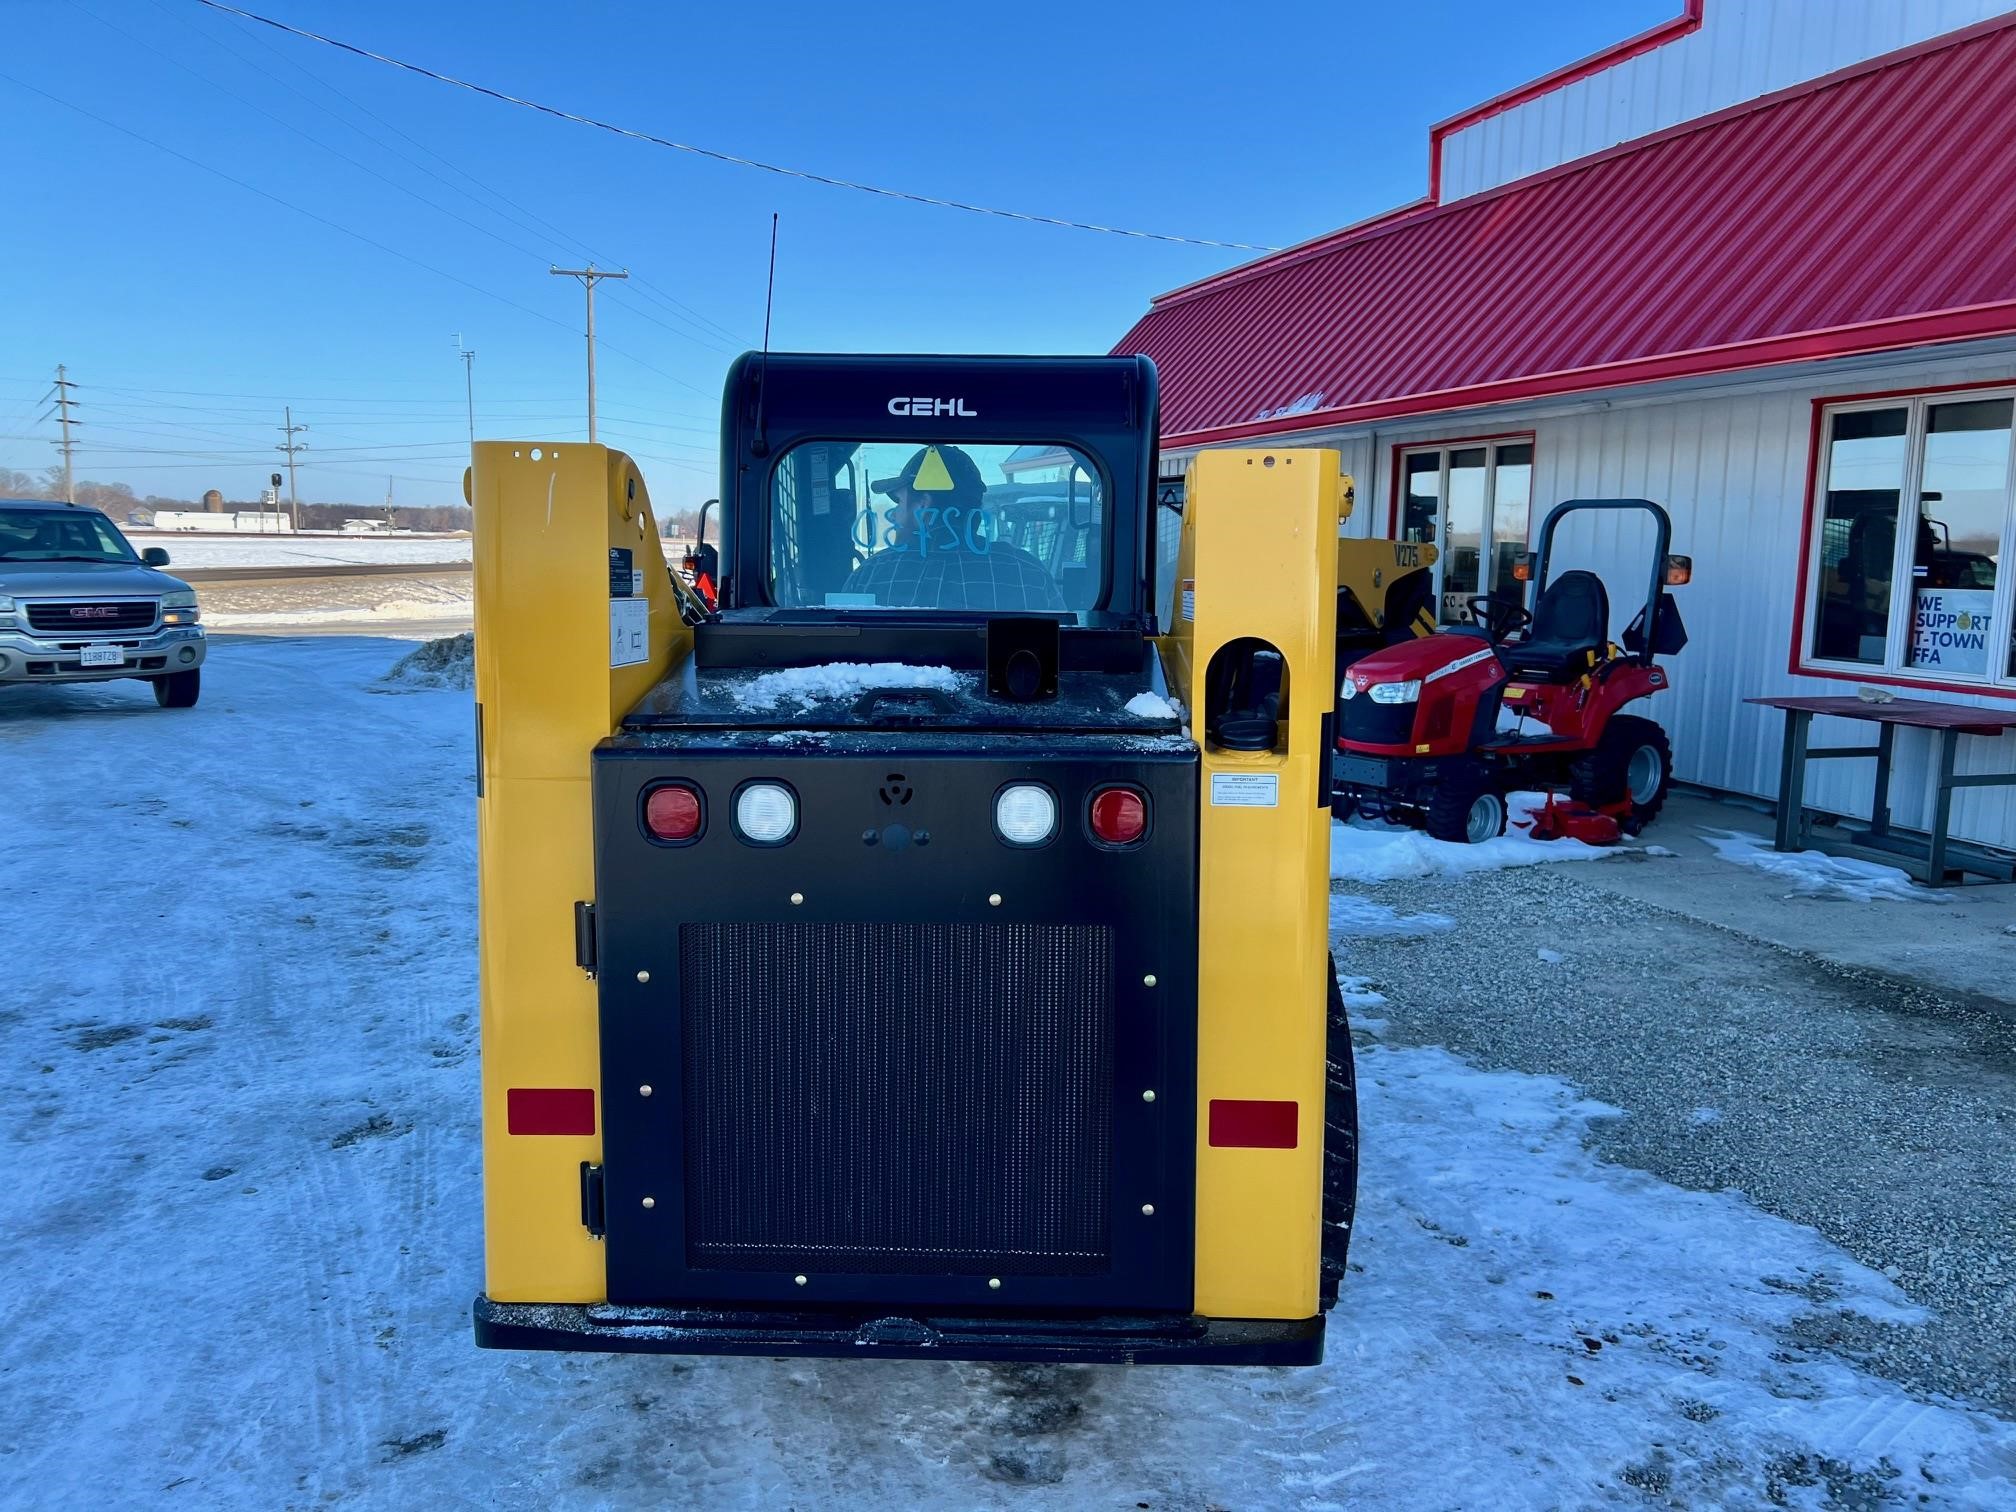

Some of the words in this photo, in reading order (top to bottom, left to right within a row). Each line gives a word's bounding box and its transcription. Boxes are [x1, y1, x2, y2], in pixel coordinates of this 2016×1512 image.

[888, 397, 978, 416] GEHL
[1394, 543, 1419, 567] V275
[70, 606, 120, 618] GMC
[1918, 596, 1942, 611] WE
[1914, 630, 1984, 649] T-TOWN
[1912, 647, 1941, 664] FFA
